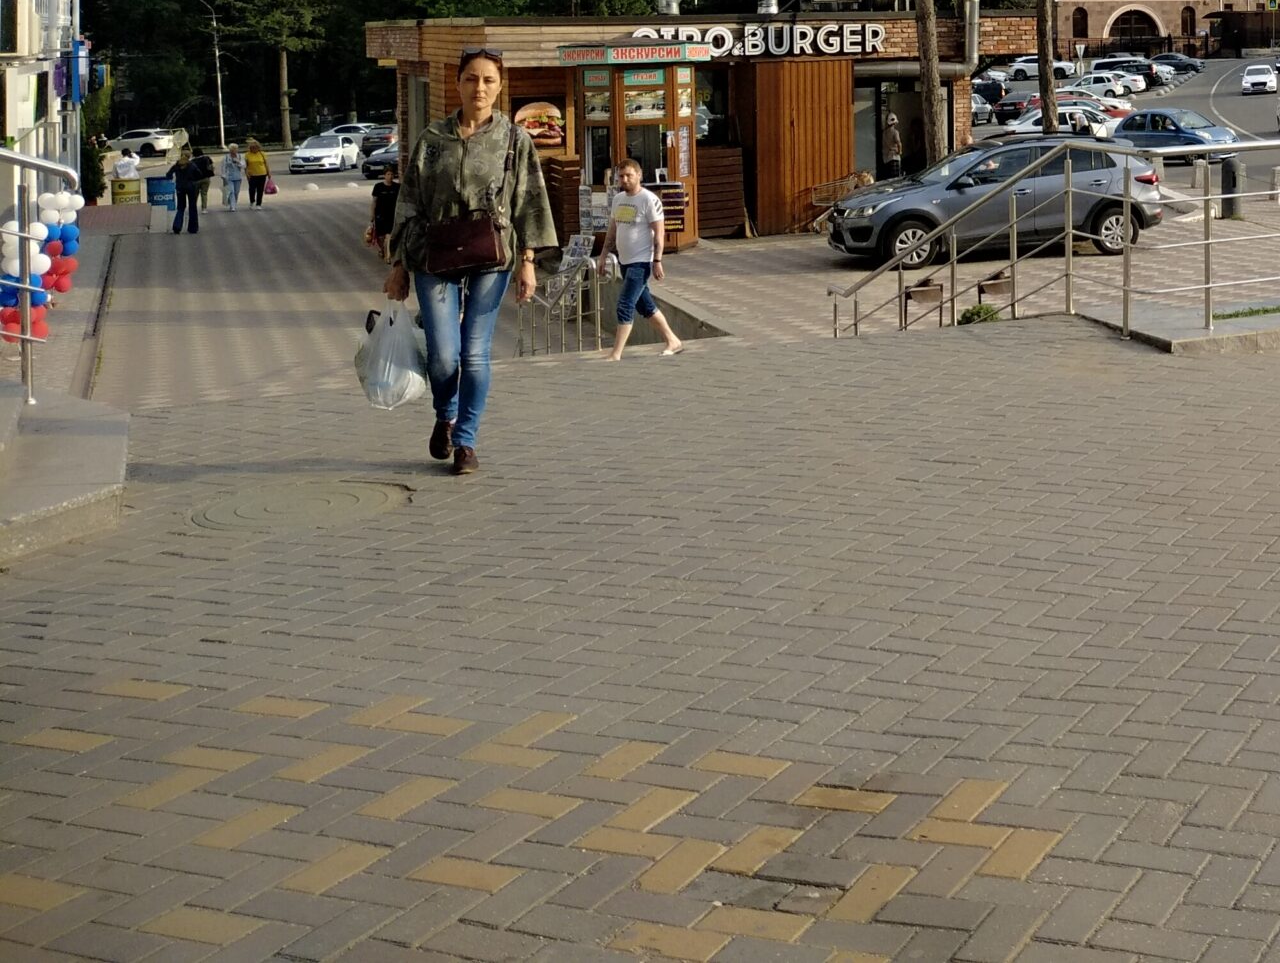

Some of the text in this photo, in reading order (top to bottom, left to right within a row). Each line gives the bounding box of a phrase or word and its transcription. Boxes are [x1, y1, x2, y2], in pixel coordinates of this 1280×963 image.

[744, 24, 886, 56] BURGER
[562, 48, 605, 61] ЭКСКУРСИИ
[612, 46, 681, 60] ЭКСКУРСИИ
